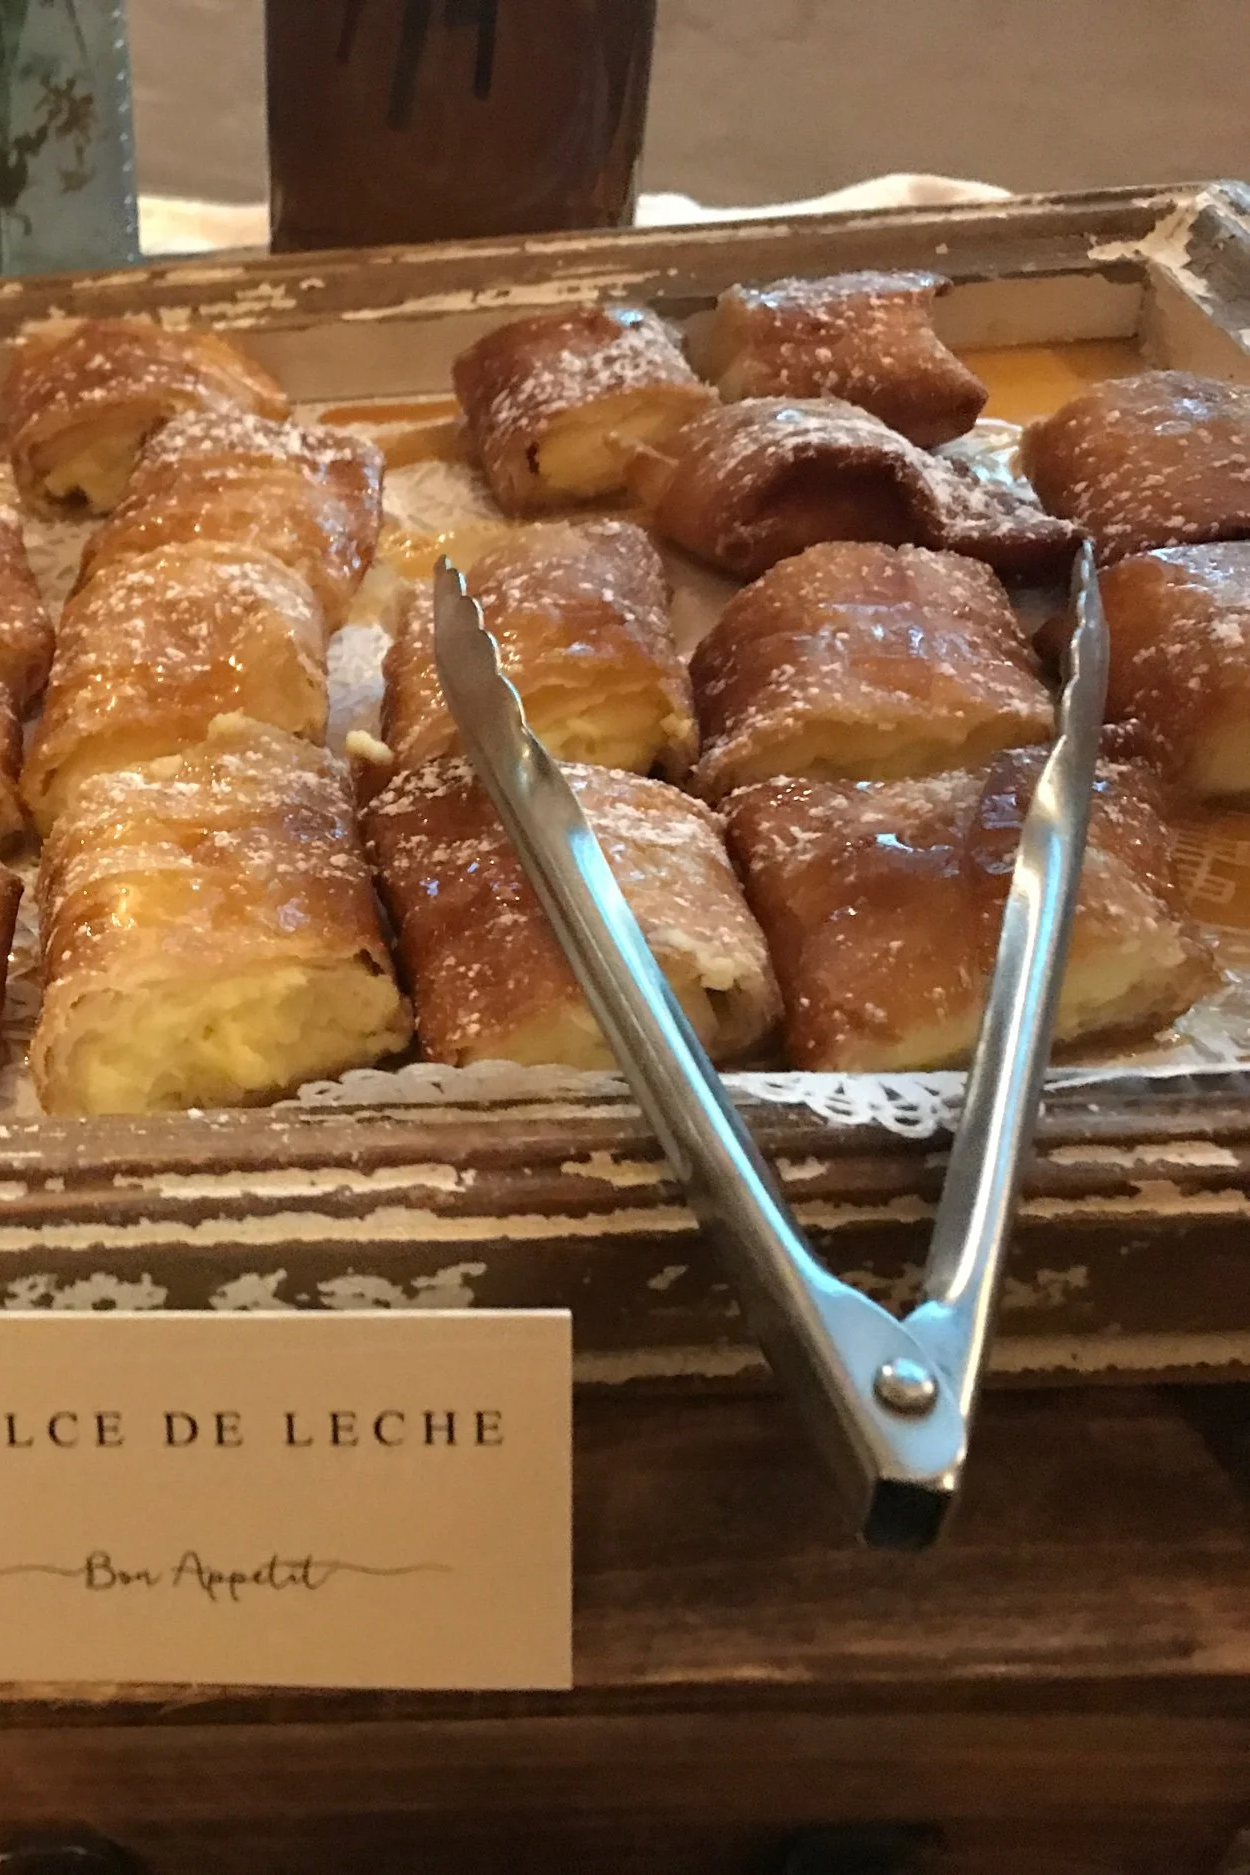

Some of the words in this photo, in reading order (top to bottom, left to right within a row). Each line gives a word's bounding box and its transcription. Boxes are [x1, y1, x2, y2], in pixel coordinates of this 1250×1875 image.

[163, 1410, 243, 1448] DE
[285, 1409, 504, 1448] LECHE
[86, 1550, 162, 1591] Bon
